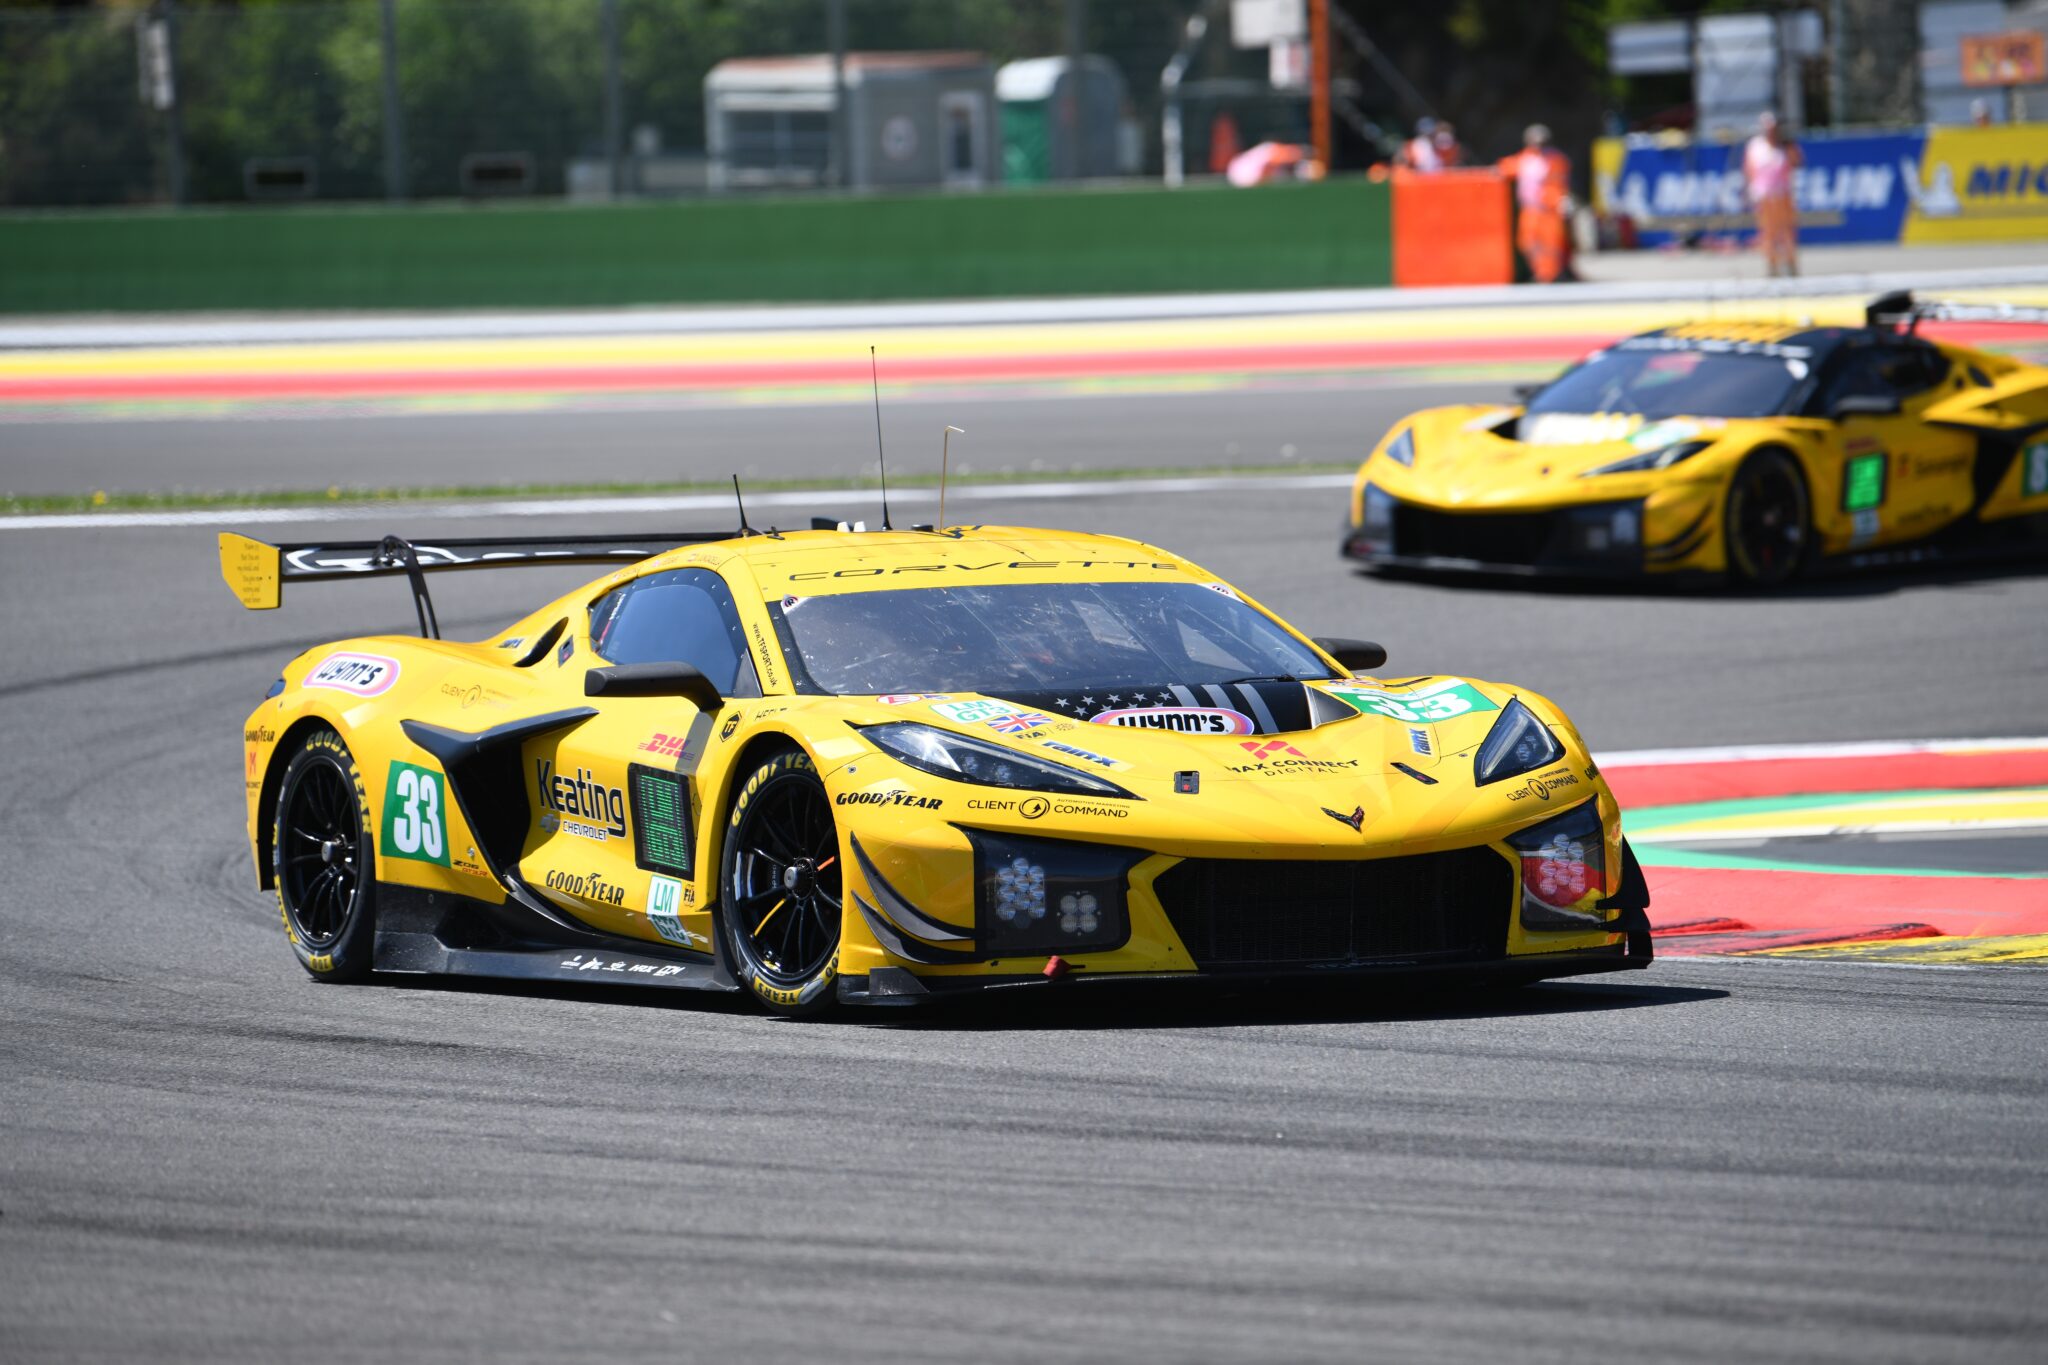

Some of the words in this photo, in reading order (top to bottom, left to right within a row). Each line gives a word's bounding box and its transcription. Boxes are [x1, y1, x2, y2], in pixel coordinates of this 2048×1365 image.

[1656, 163, 1893, 215] MICELIN
[789, 561, 1178, 581] CORVETTE
[952, 700, 993, 711] LM
[956, 707, 1012, 721] GT3
[645, 733, 690, 758] DHL
[1264, 767, 1338, 777] DIGITAL
[1272, 759, 1359, 768] CONNECT
[536, 758, 627, 838] Keating
[1506, 787, 1532, 802] CLIENT
[1544, 774, 1579, 790] COMMAND
[836, 789, 943, 811] GOODYEAR
[967, 799, 1016, 811] CLIENT
[1054, 804, 1129, 818] COMMAND
[394, 769, 443, 858] 33
[562, 820, 607, 840] CHEVROLET
[545, 869, 625, 906] GOODYEAR
[654, 882, 675, 913] LM
